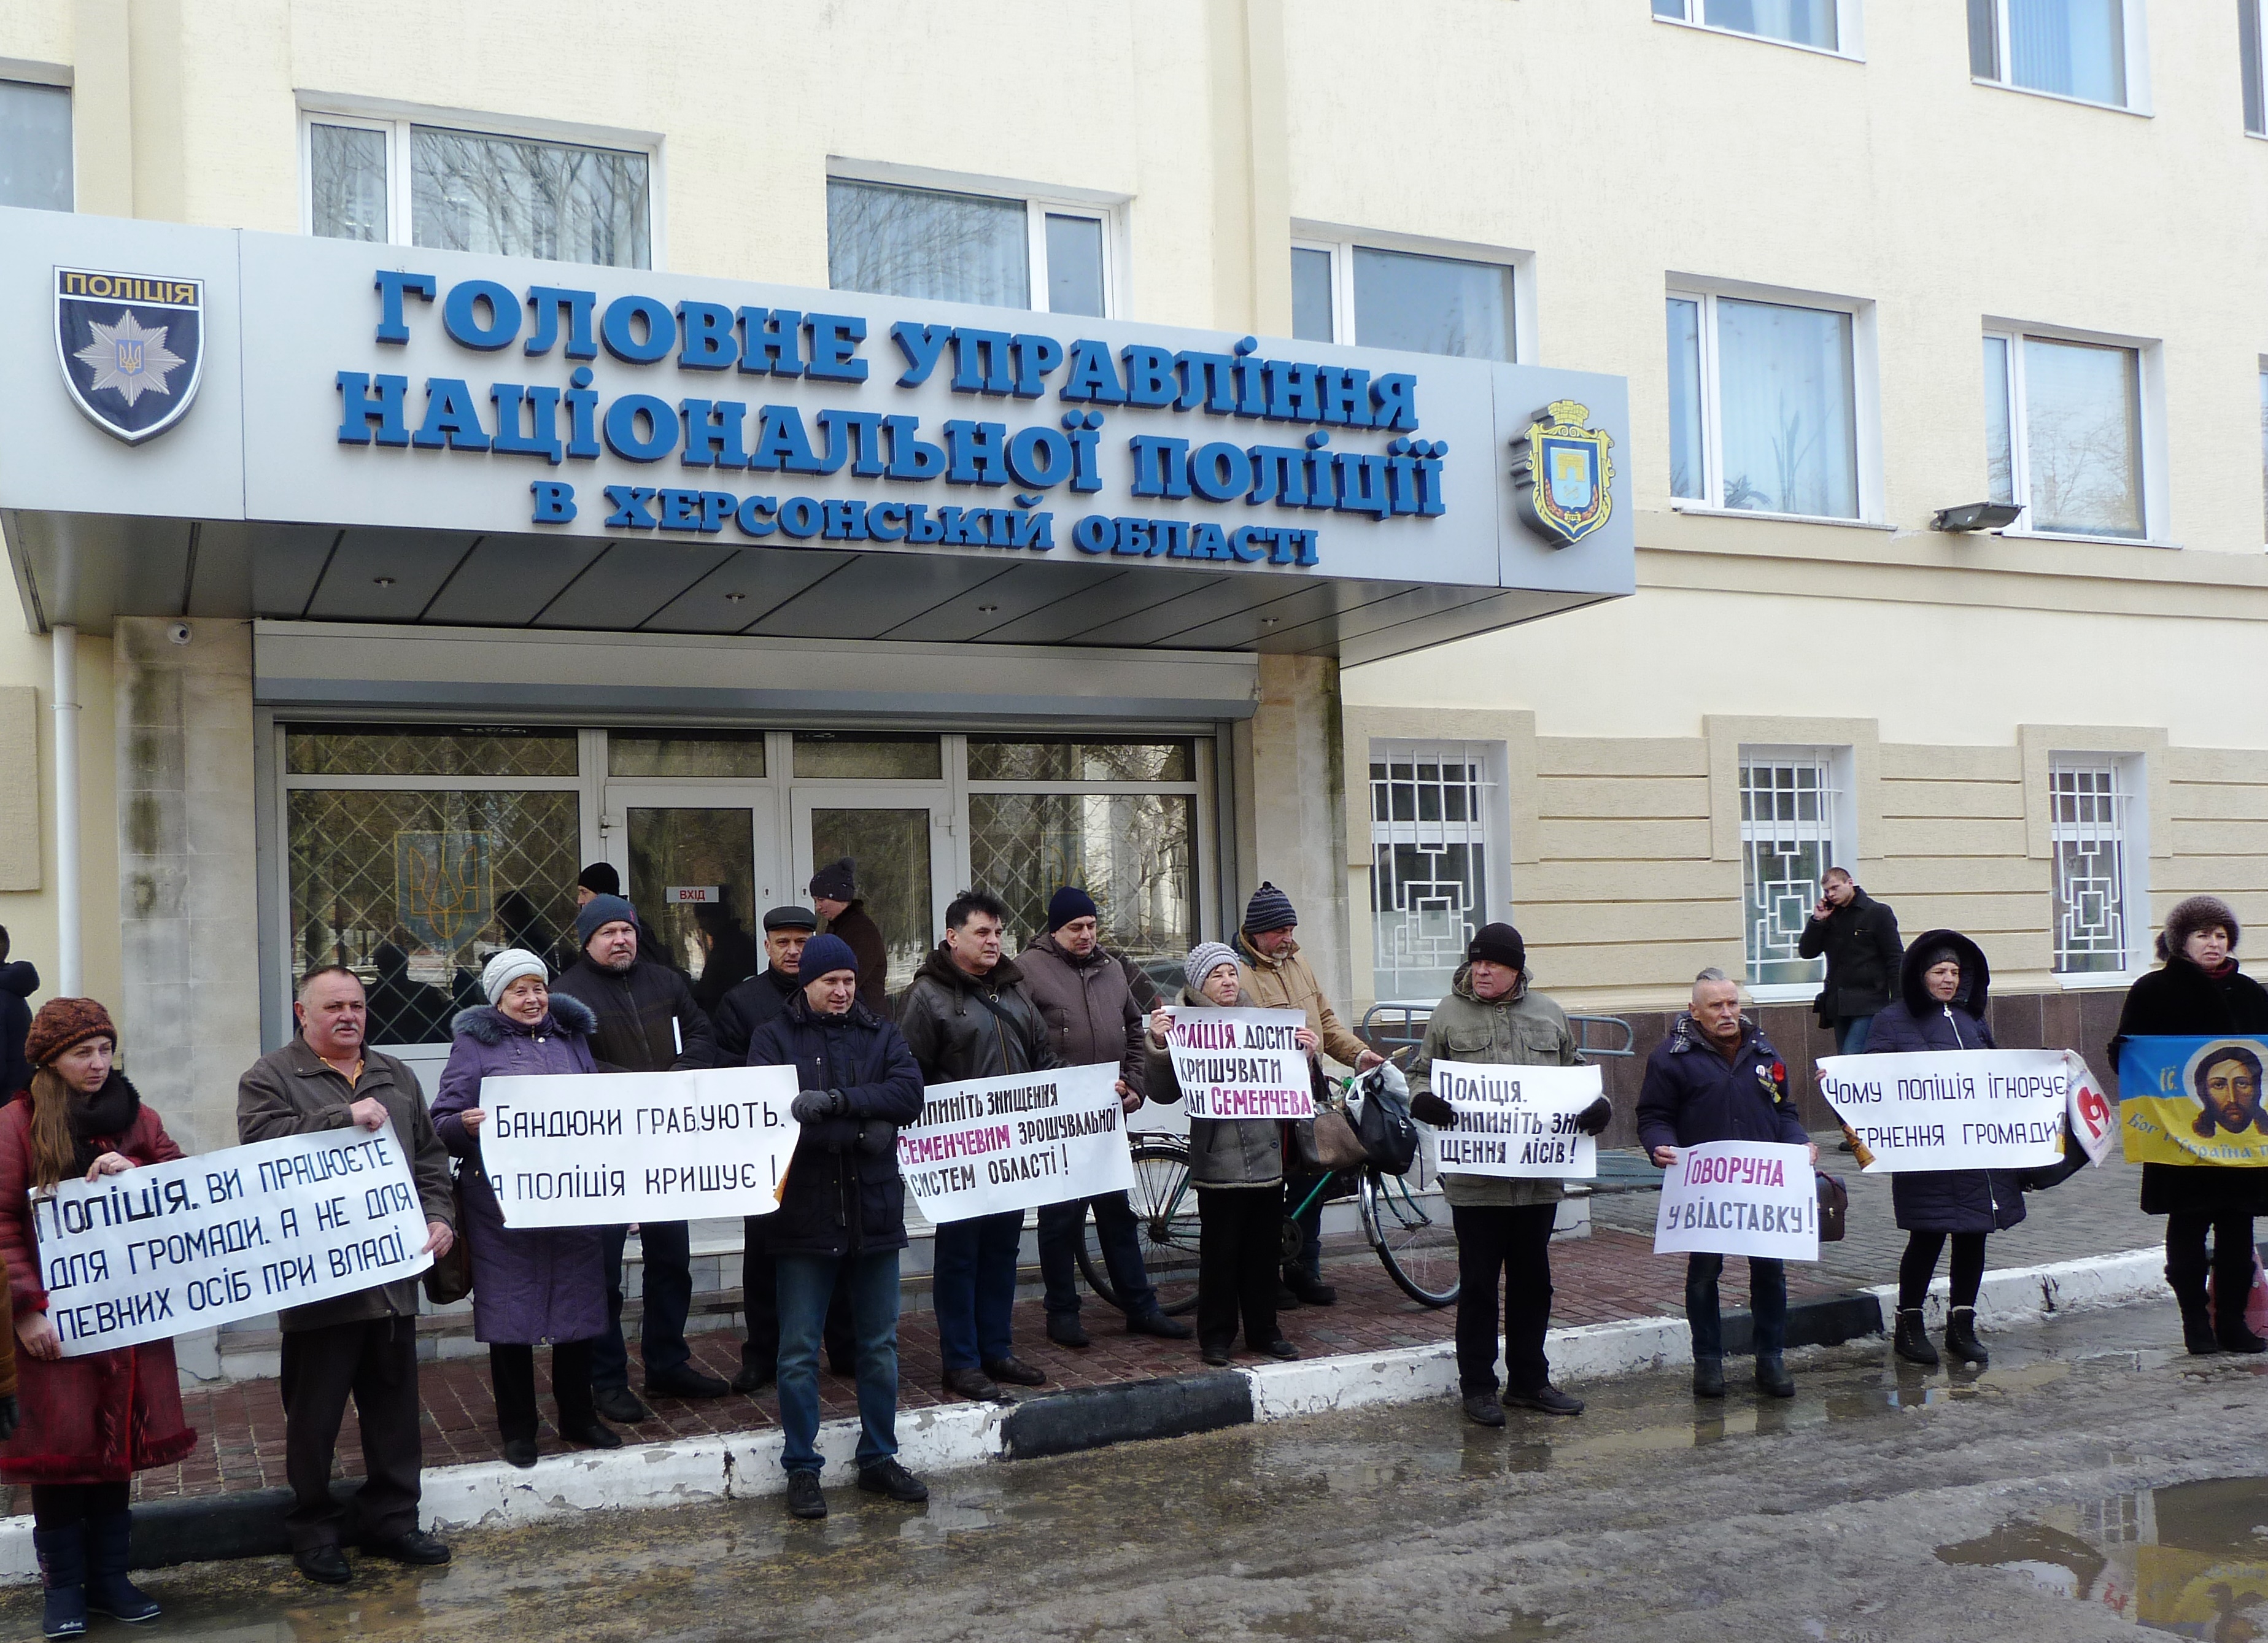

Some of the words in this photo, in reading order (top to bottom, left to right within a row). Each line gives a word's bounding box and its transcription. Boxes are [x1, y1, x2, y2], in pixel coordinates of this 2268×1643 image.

[66, 274, 194, 304] ПОЛІЦІЯ
[374, 269, 869, 384] ГОЛОВНЕ
[891, 320, 1418, 433] УПРАВЛІННЯ
[336, 367, 1105, 493] НАЦІОНАЛЬНОЇ
[1130, 430, 1449, 521] ПОЛІЦІЇ
[530, 481, 577, 525] В
[603, 485, 1055, 552] ХЕРСОНСЬКІЙ
[1072, 514, 1320, 566] ОБЛАСТІ
[679, 890, 706, 901] ВХІД
[1179, 1057, 1282, 1083] КРИШУВАТИ
[986, 1083, 1058, 1116] ЗНИЩЕННЯ
[1211, 1086, 1312, 1115] СЕМЕНЧЕВА
[1826, 1078, 1882, 1104] ЧОМУ
[1898, 1073, 1975, 1102] ПОЛІЦІЯ
[496, 1105, 622, 1139] БАНДЮКИ
[897, 1124, 1011, 1166] СЕМЕНЧЕВИМ
[1018, 1101, 1120, 1145] ЗРОШУВАЛЬНОЇ
[1438, 1107, 1542, 1135] РИПИНІТЬ
[1441, 1139, 1507, 1165] ЩЕННЯ
[1684, 1150, 1785, 1188] ГОВОРУНА
[207, 1169, 244, 1205] ВИ
[258, 1137, 393, 1194] ПРАЦЮЄТЕ
[517, 1164, 625, 1201] ПОЛІЦІЯ
[910, 1164, 976, 1198] СИСТЕМ
[49, 1249, 110, 1292] ДЛЯ
[281, 1208, 300, 1239] А
[314, 1196, 350, 1232] НЕ
[366, 1181, 415, 1220] ДЛЯ
[56, 1287, 174, 1342] ПЕВНИХ
[187, 1267, 252, 1312] ОСІБ
[263, 1255, 317, 1296] ПРИ
